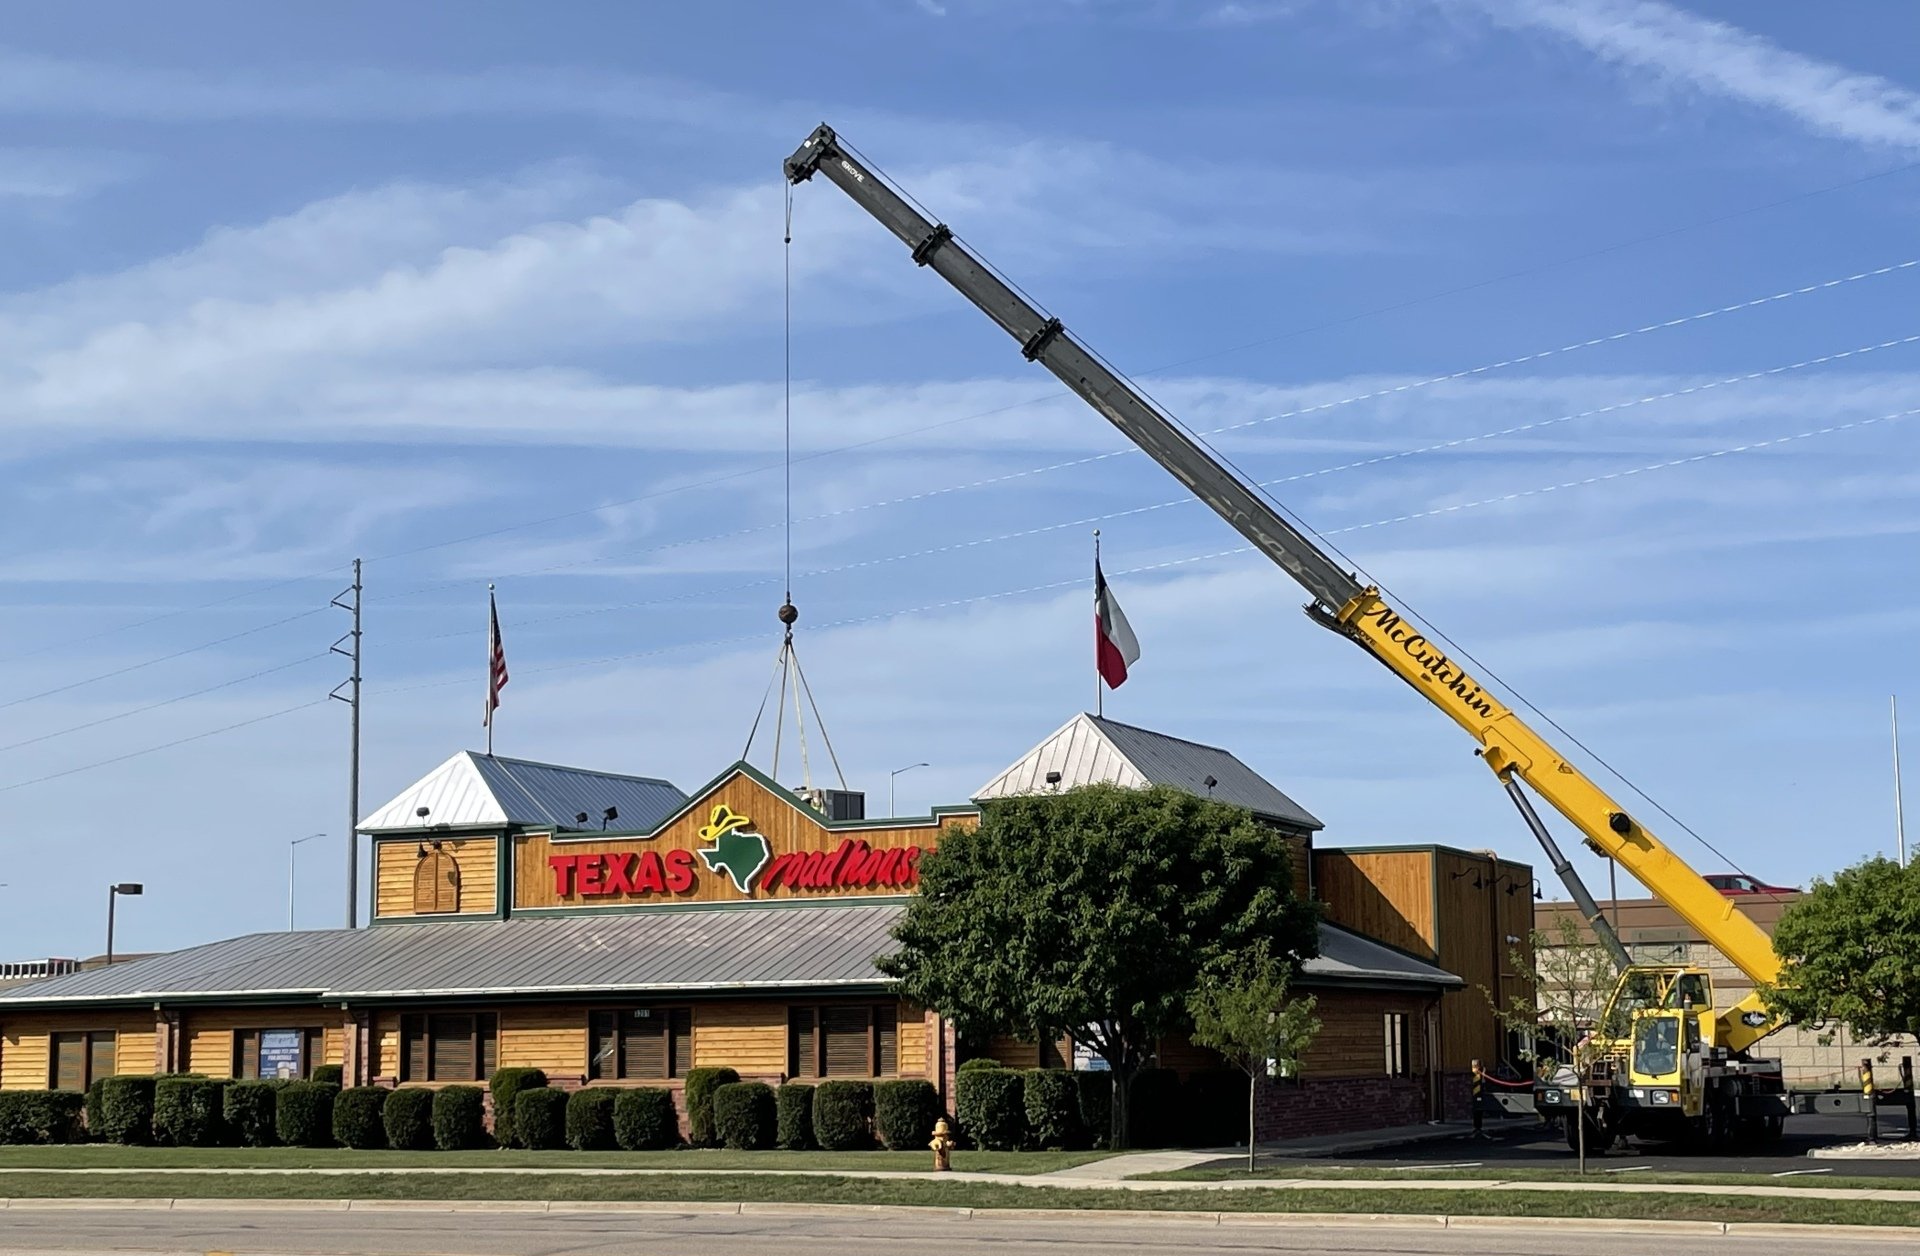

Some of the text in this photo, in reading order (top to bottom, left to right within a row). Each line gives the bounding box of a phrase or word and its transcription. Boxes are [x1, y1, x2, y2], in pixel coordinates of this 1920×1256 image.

[841, 160, 865, 183] GROVE
[1362, 607, 1493, 719] McCutchin
[548, 849, 697, 896] TEXAS
